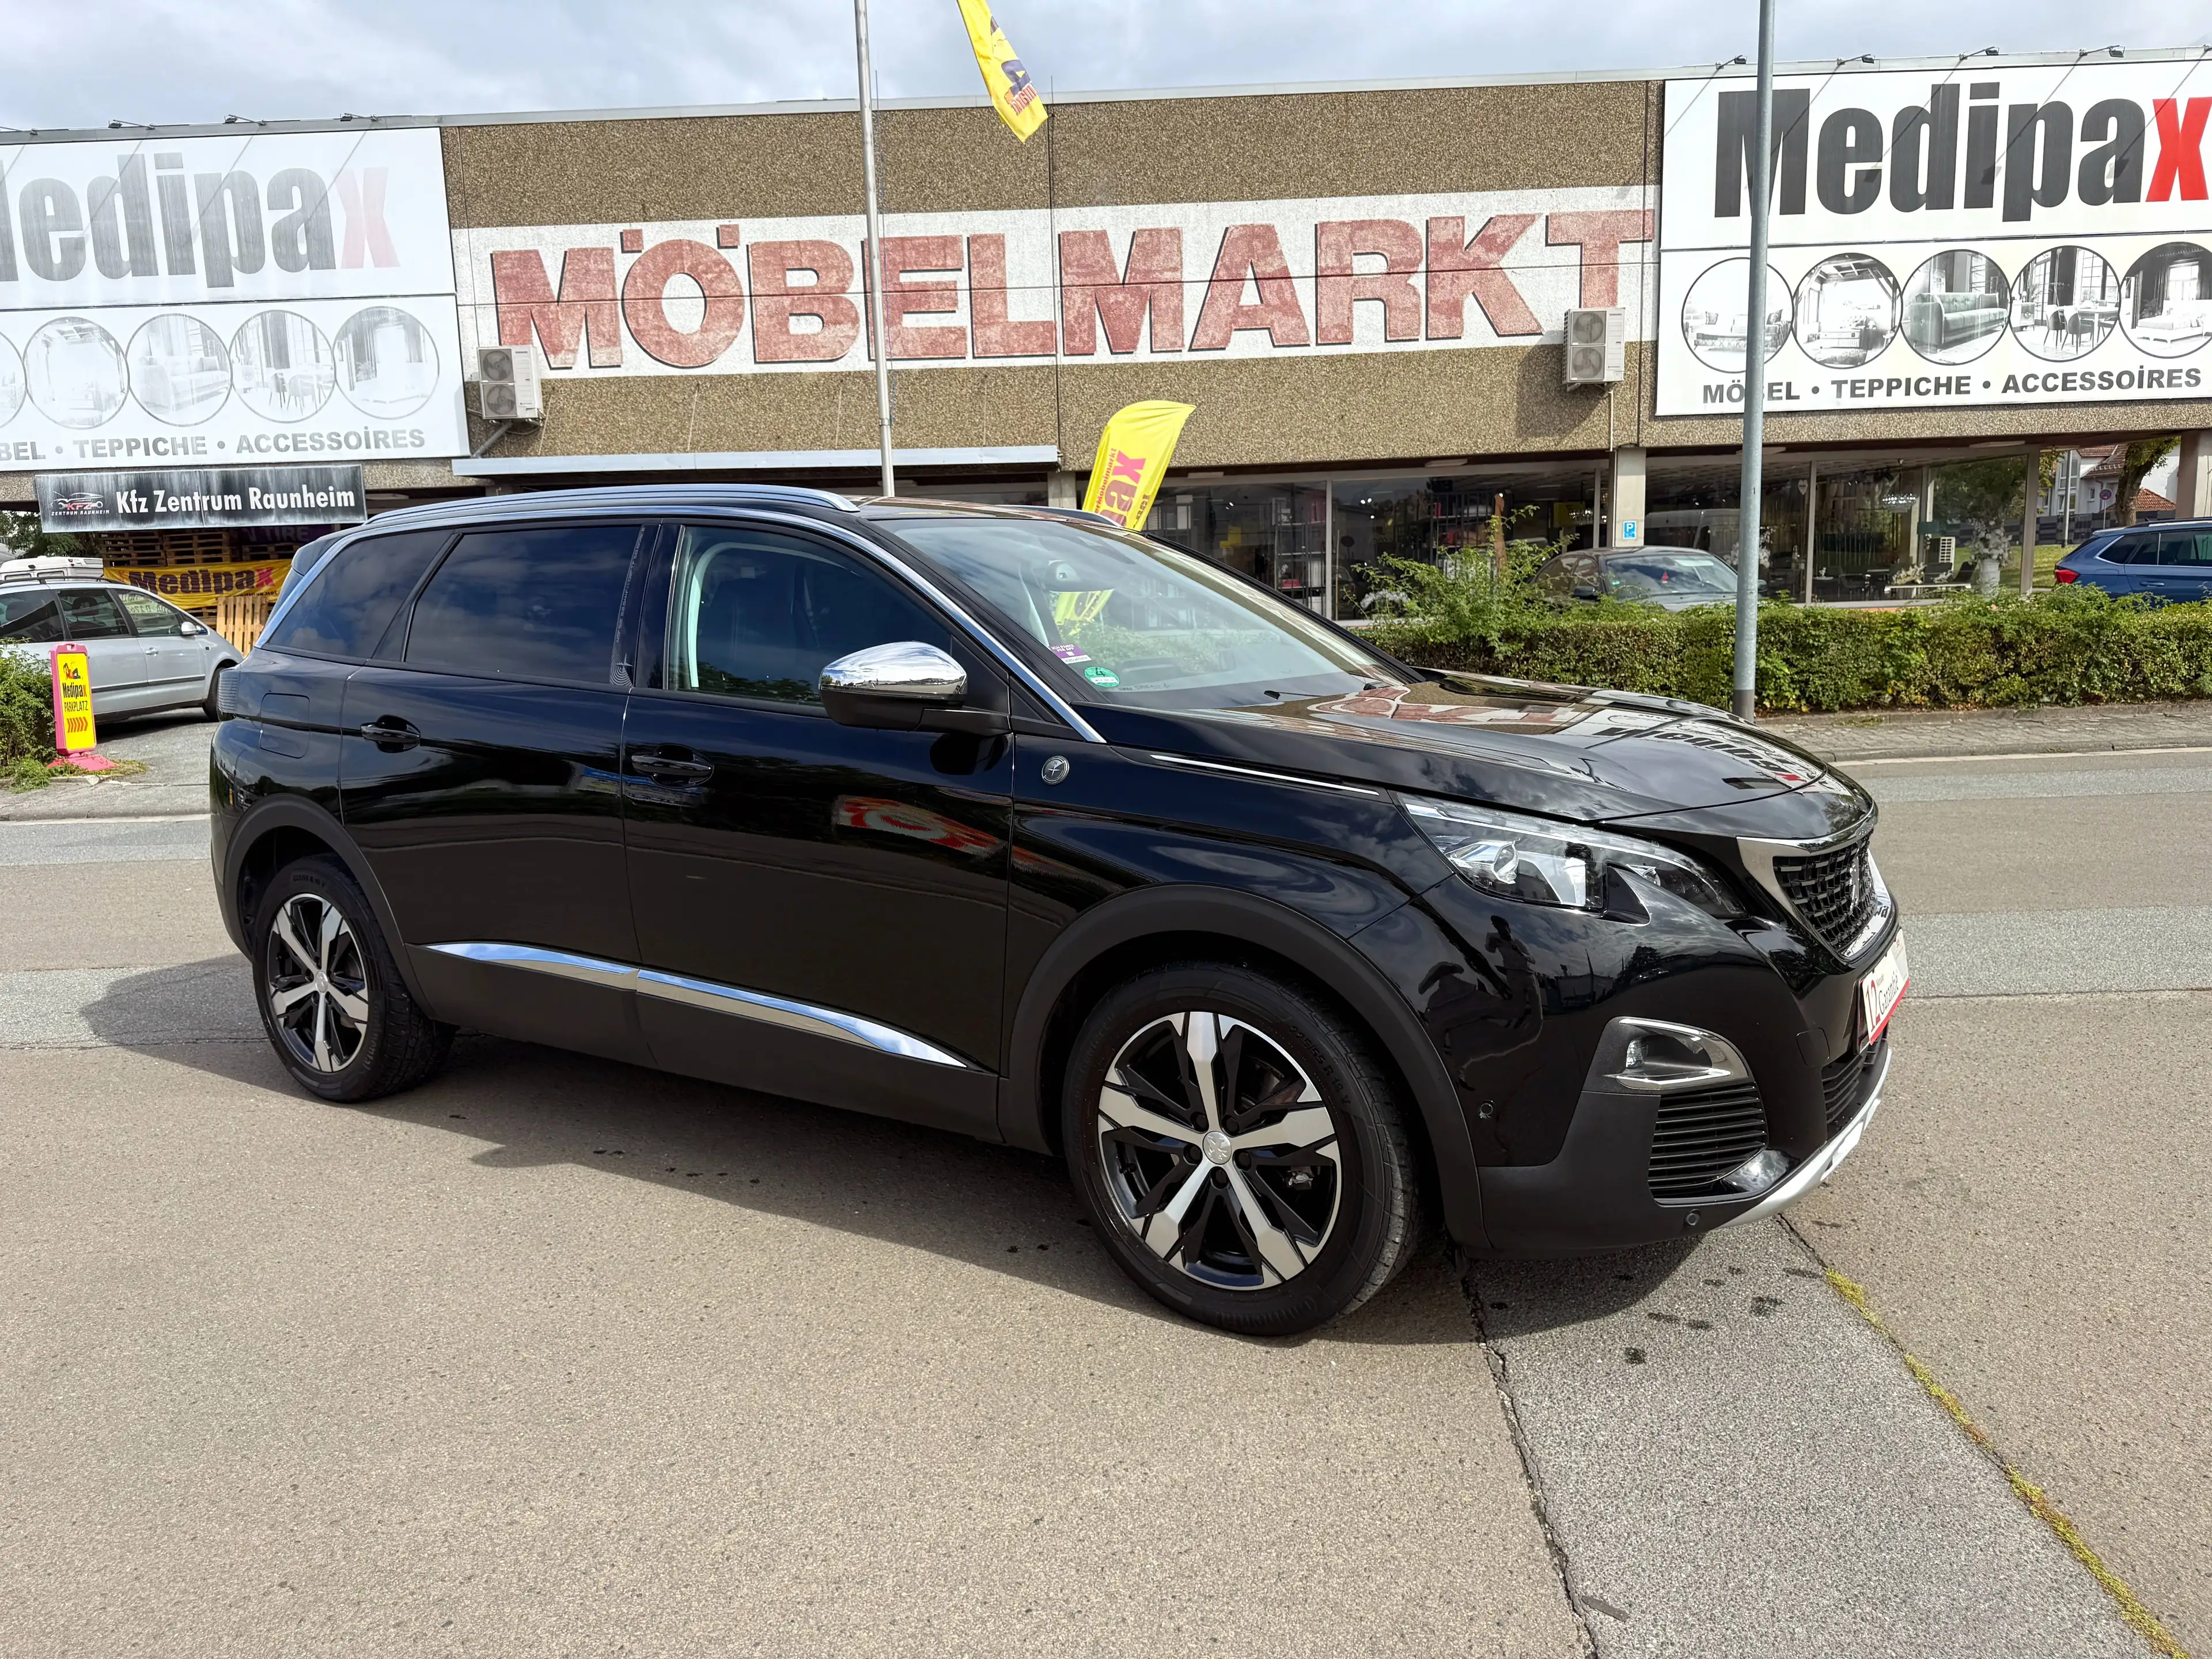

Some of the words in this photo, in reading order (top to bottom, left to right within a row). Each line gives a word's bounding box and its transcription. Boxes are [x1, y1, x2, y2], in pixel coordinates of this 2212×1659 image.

[1714, 82, 2212, 222] Medipax
[0, 152, 401, 288] edipax
[491, 210, 1655, 370] MÖBELMARKT
[1703, 379, 1800, 404] MÖEL
[1831, 374, 1971, 399] TEPPICHE
[73, 435, 208, 459] TEPPICHE
[116, 489, 149, 513] Kfz
[154, 490, 242, 513] Zentrum
[249, 484, 355, 510] Raunheim
[1626, 523, 1634, 533] P
[129, 566, 276, 595] Medipax
[62, 682, 87, 699] Medipax
[64, 700, 89, 713] PARKPLATZ
[1878, 970, 1899, 1015] Garantie
